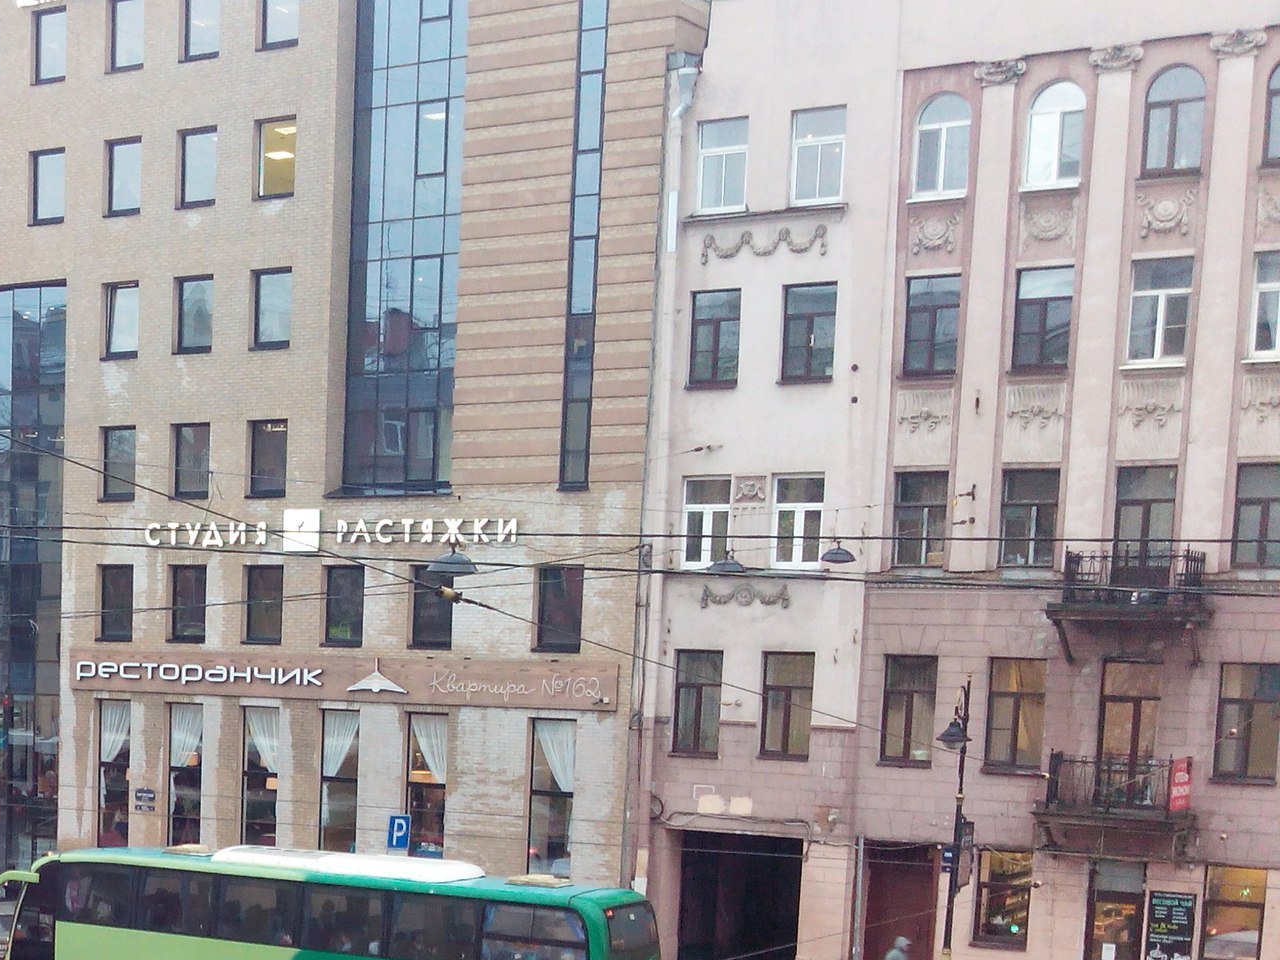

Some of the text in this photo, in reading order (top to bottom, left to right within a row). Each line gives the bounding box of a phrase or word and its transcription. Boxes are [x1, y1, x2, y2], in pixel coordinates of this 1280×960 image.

[144, 517, 518, 548] СТУДИЯ РАСТЯЖКИ
[75, 660, 324, 687] ресторанчик
[428, 669, 602, 702] Квартира №162
[392, 818, 407, 846] P
